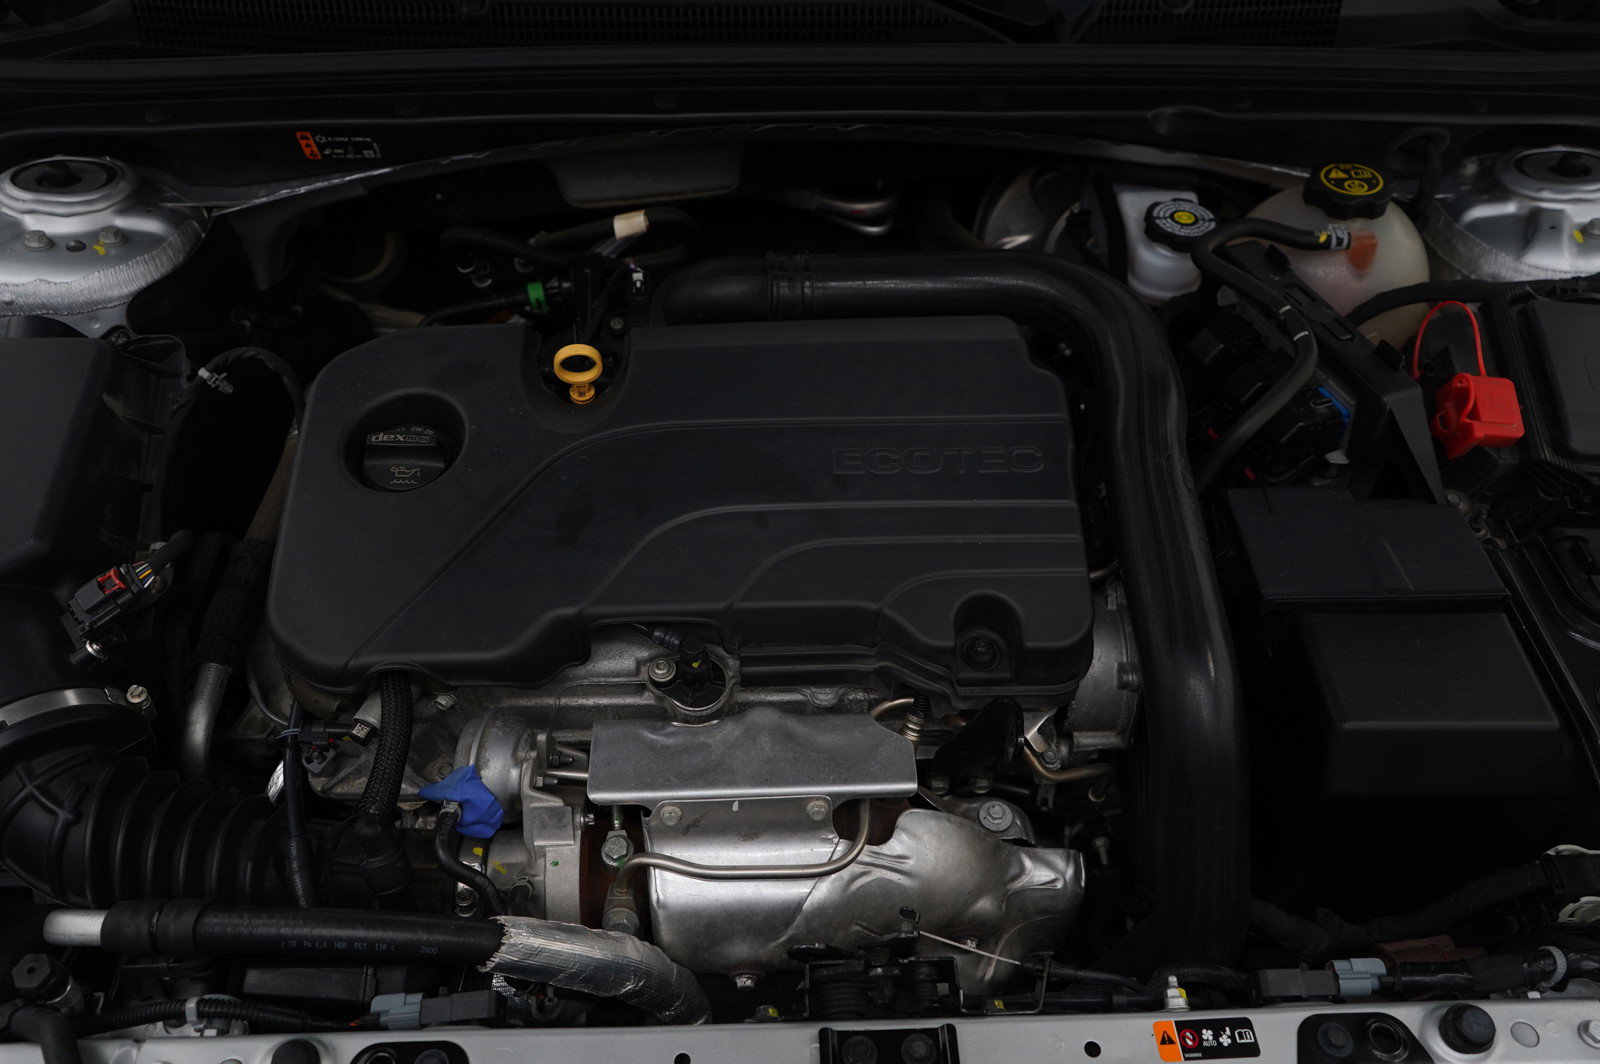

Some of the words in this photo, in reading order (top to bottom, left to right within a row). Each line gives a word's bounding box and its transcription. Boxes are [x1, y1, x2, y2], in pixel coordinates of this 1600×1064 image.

[371, 433, 430, 443] dexos
[832, 446, 1046, 475] ECOTEC
[354, 942, 367, 950] PET
